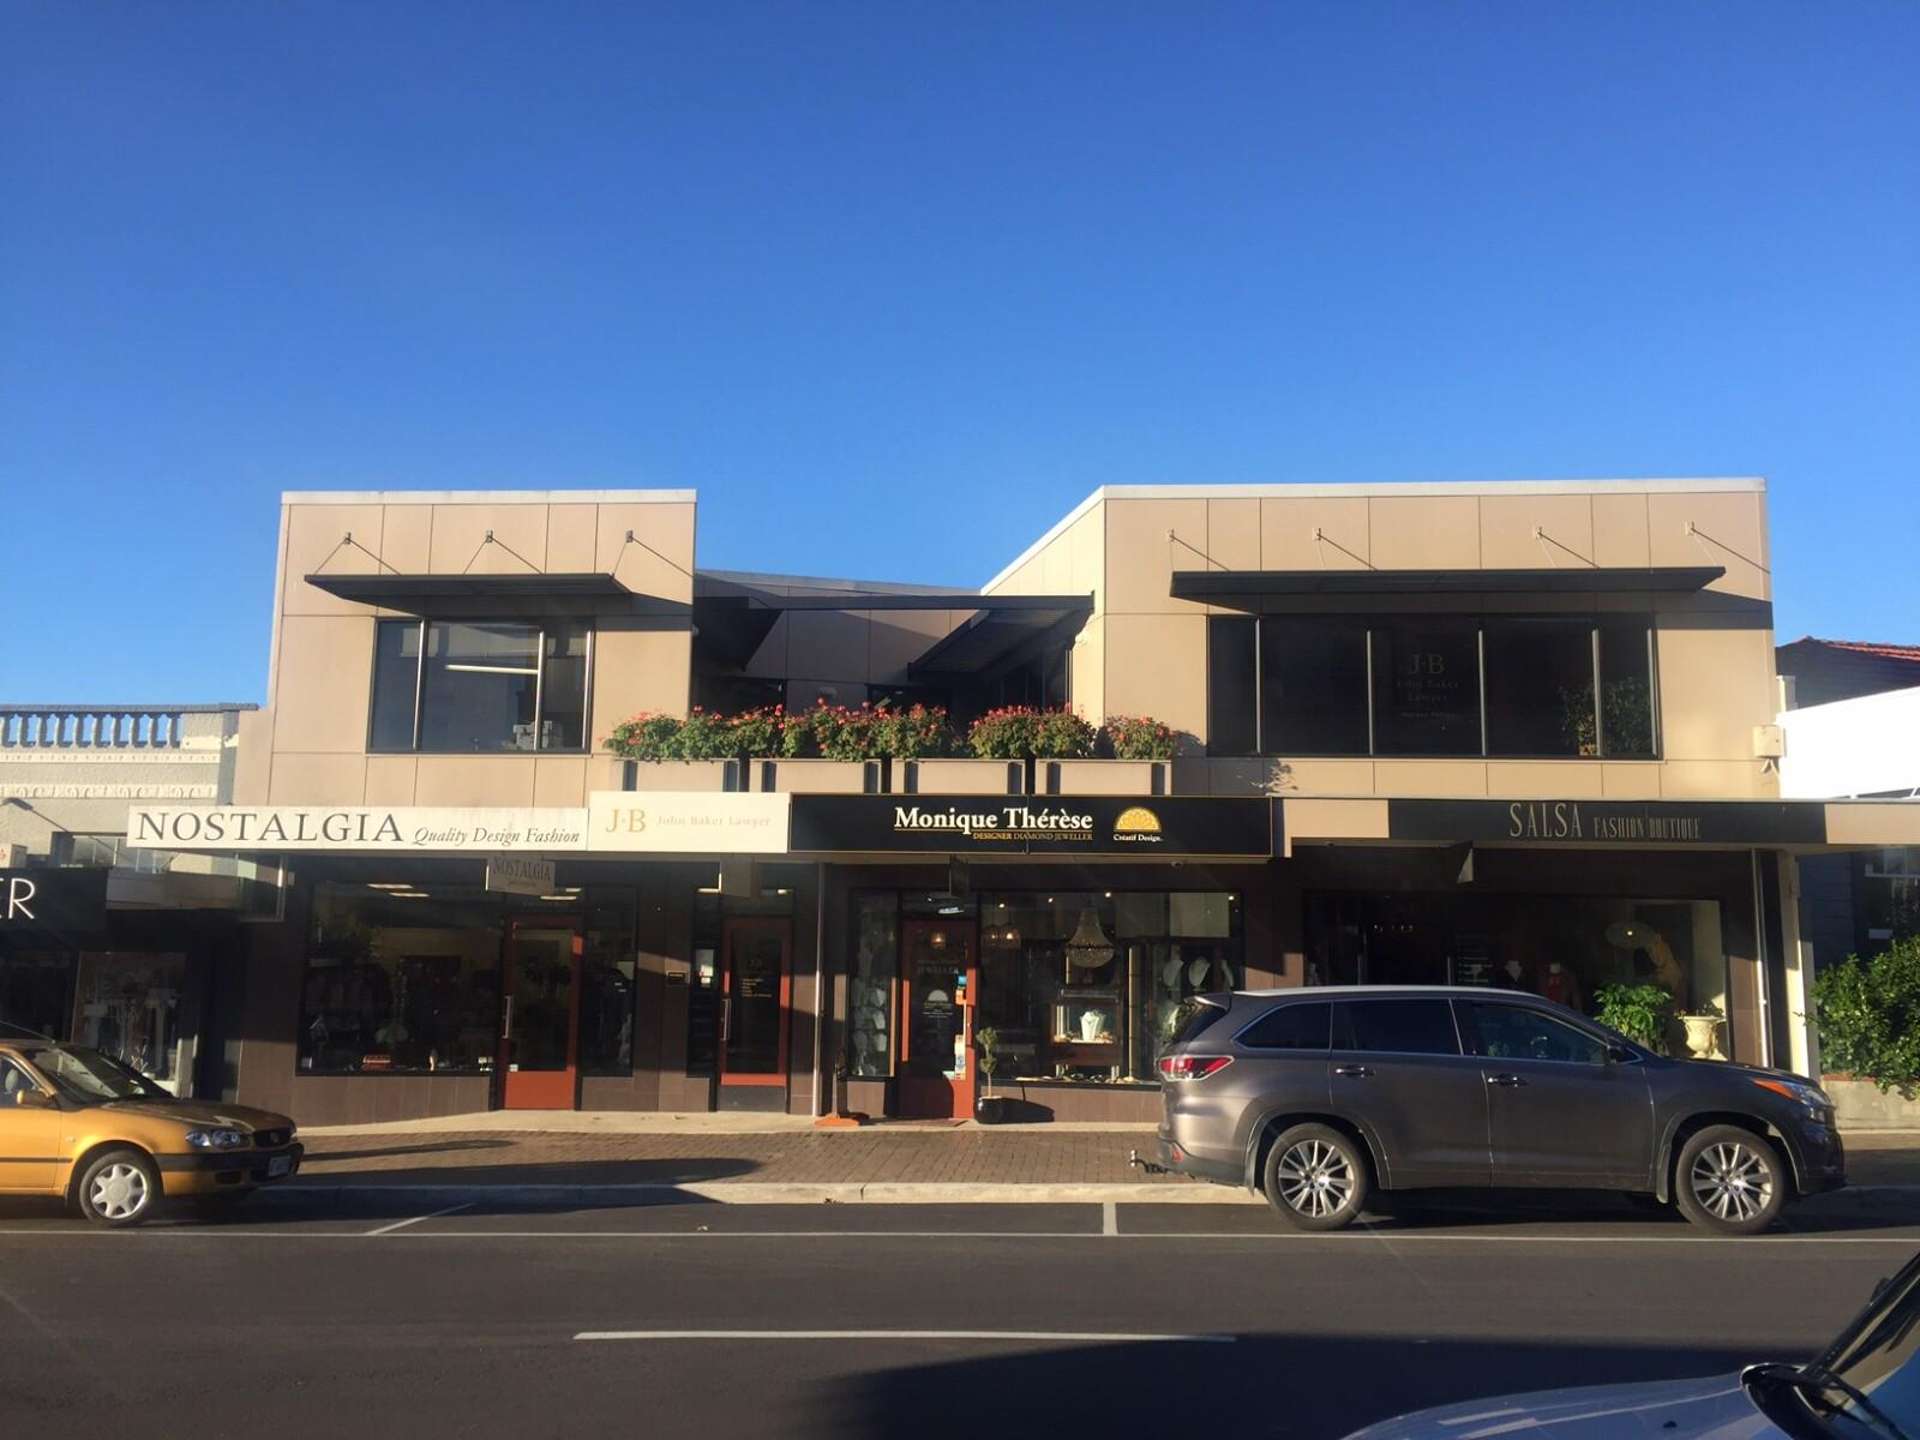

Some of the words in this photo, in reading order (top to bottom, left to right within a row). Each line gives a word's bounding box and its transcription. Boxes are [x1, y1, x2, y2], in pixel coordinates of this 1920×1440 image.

[135, 812, 403, 843] NOSTALGIA
[656, 815, 686, 826] John
[690, 815, 723, 826] Baker
[728, 815, 771, 828] Lawyer
[894, 806, 998, 835] Monique
[1002, 806, 1093, 829] Thérèse
[1509, 802, 1583, 838] SALSA
[1593, 817, 1645, 839] FASHION
[412, 826, 468, 847] Quality
[472, 827, 521, 846] Design
[525, 827, 580, 843] Fashion
[972, 832, 1012, 840] DESIGNER
[1013, 832, 1054, 841] DIAMOND
[493, 856, 552, 881] NOSTALGIA
